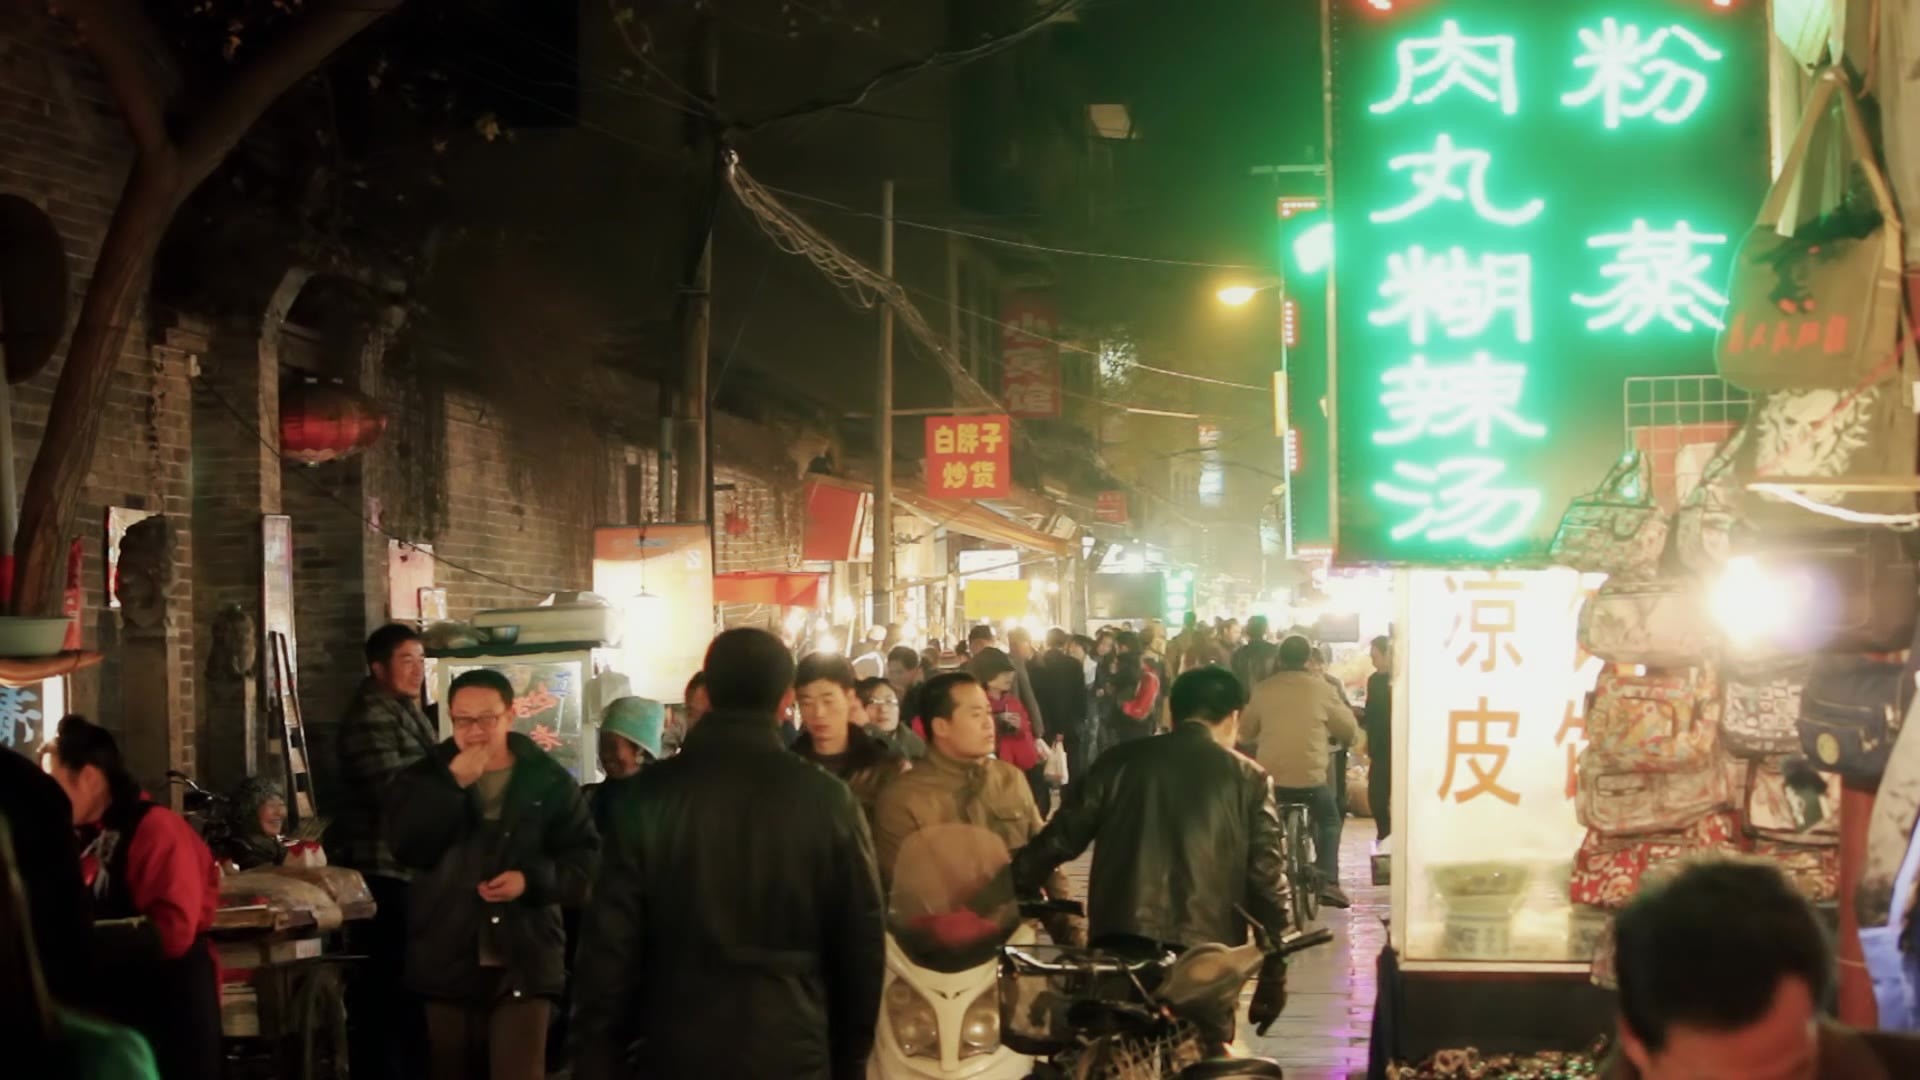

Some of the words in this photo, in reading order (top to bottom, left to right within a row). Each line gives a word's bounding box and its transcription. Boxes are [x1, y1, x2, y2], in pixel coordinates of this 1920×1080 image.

[1368, 18, 1548, 549] 肉丸糊辣汤
[1560, 17, 1731, 334] 粉蒸
[934, 422, 1003, 454] 白胖子
[942, 460, 997, 489] 炒货
[1436, 571, 1524, 807] 凉皮
